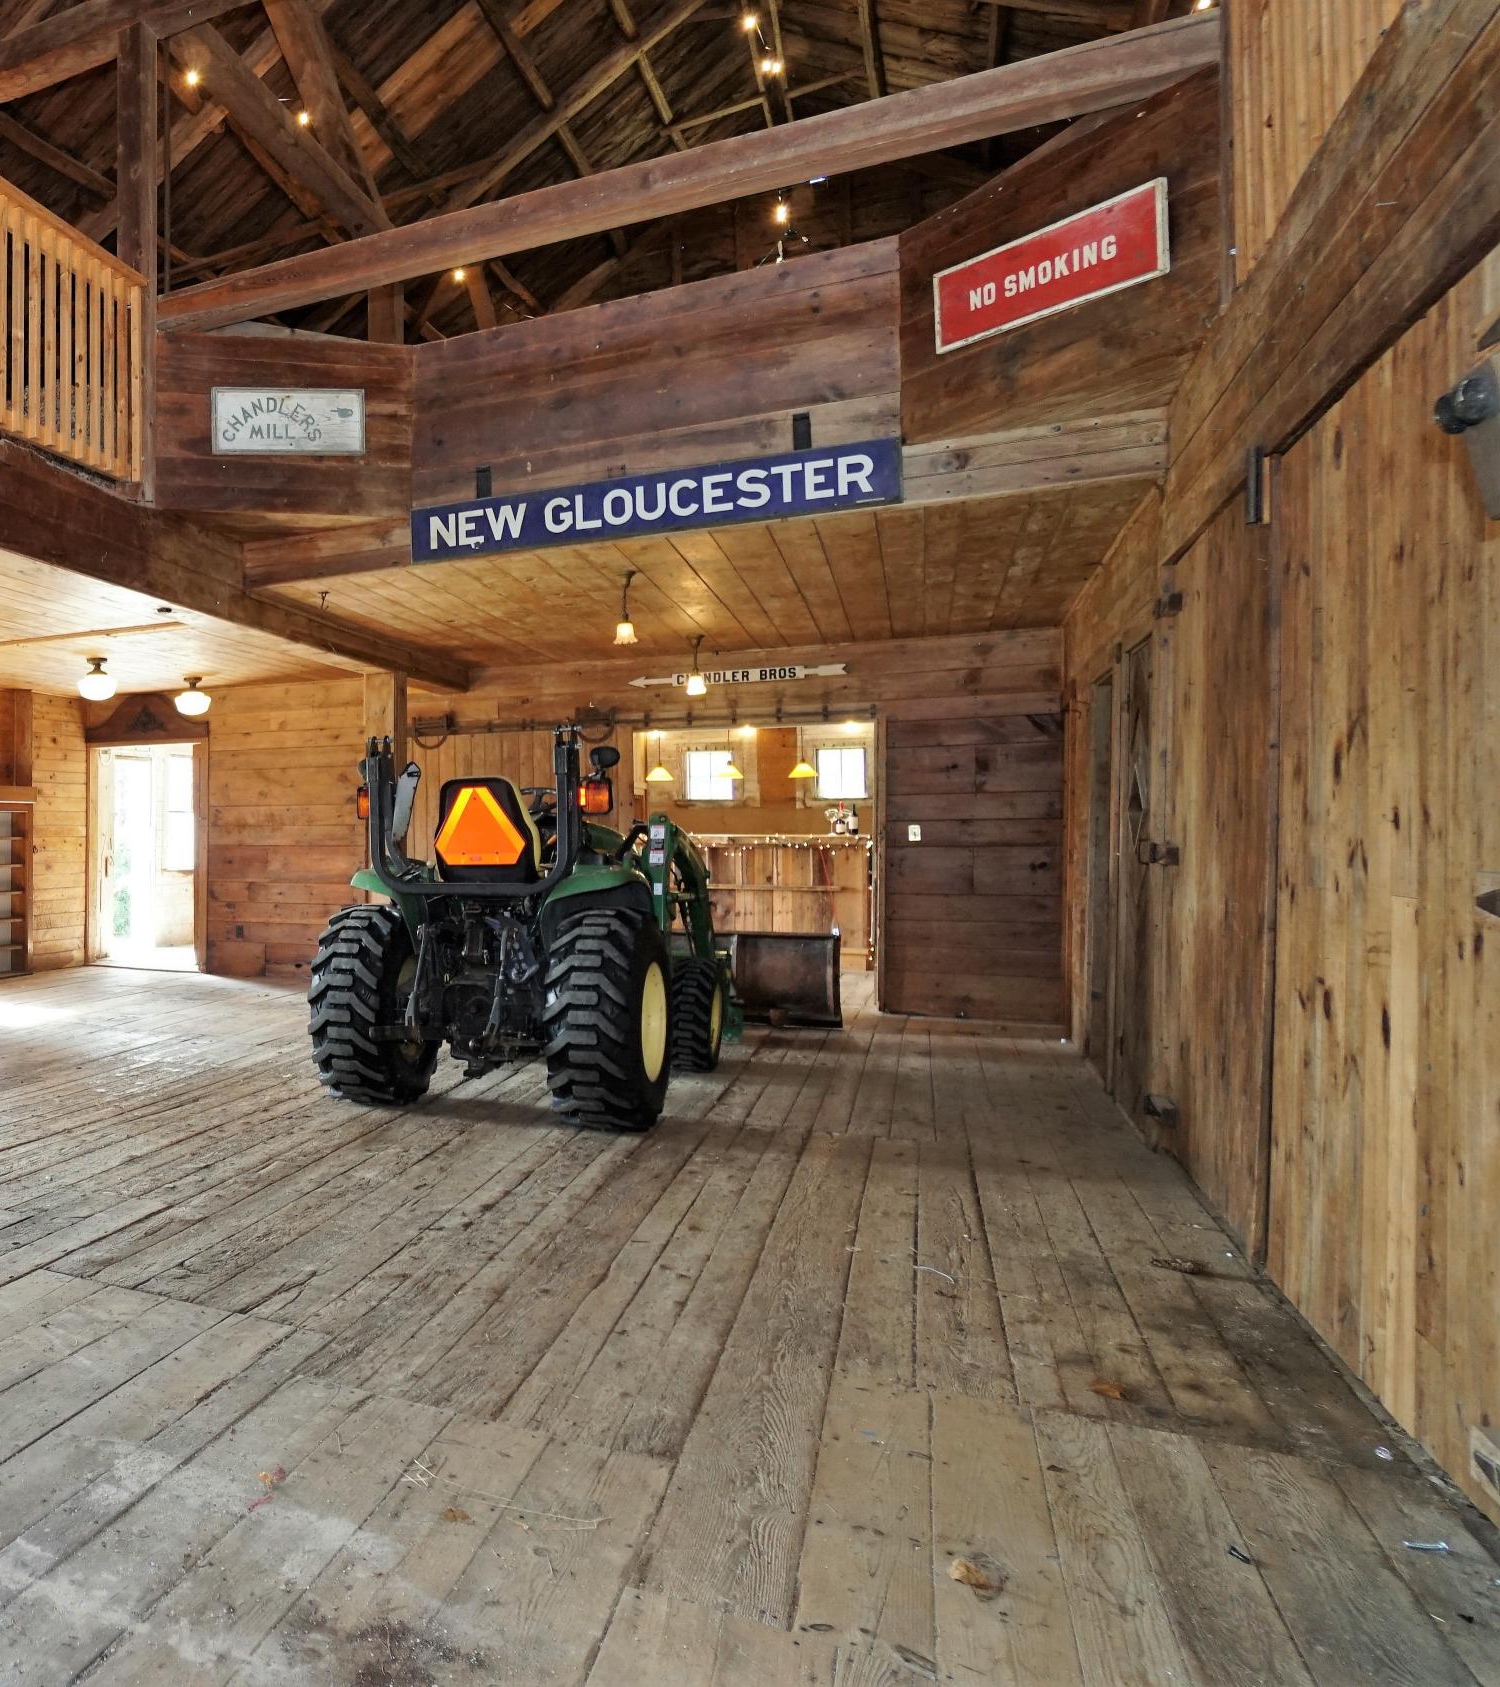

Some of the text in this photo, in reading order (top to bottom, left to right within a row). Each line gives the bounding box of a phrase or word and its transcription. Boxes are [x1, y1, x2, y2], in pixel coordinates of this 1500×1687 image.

[969, 235, 1118, 312] NO SMOKING
[249, 424, 296, 440] MILL
[429, 453, 875, 550] NEW GLOUCESTER
[676, 667, 797, 686] CNDLER BROS
